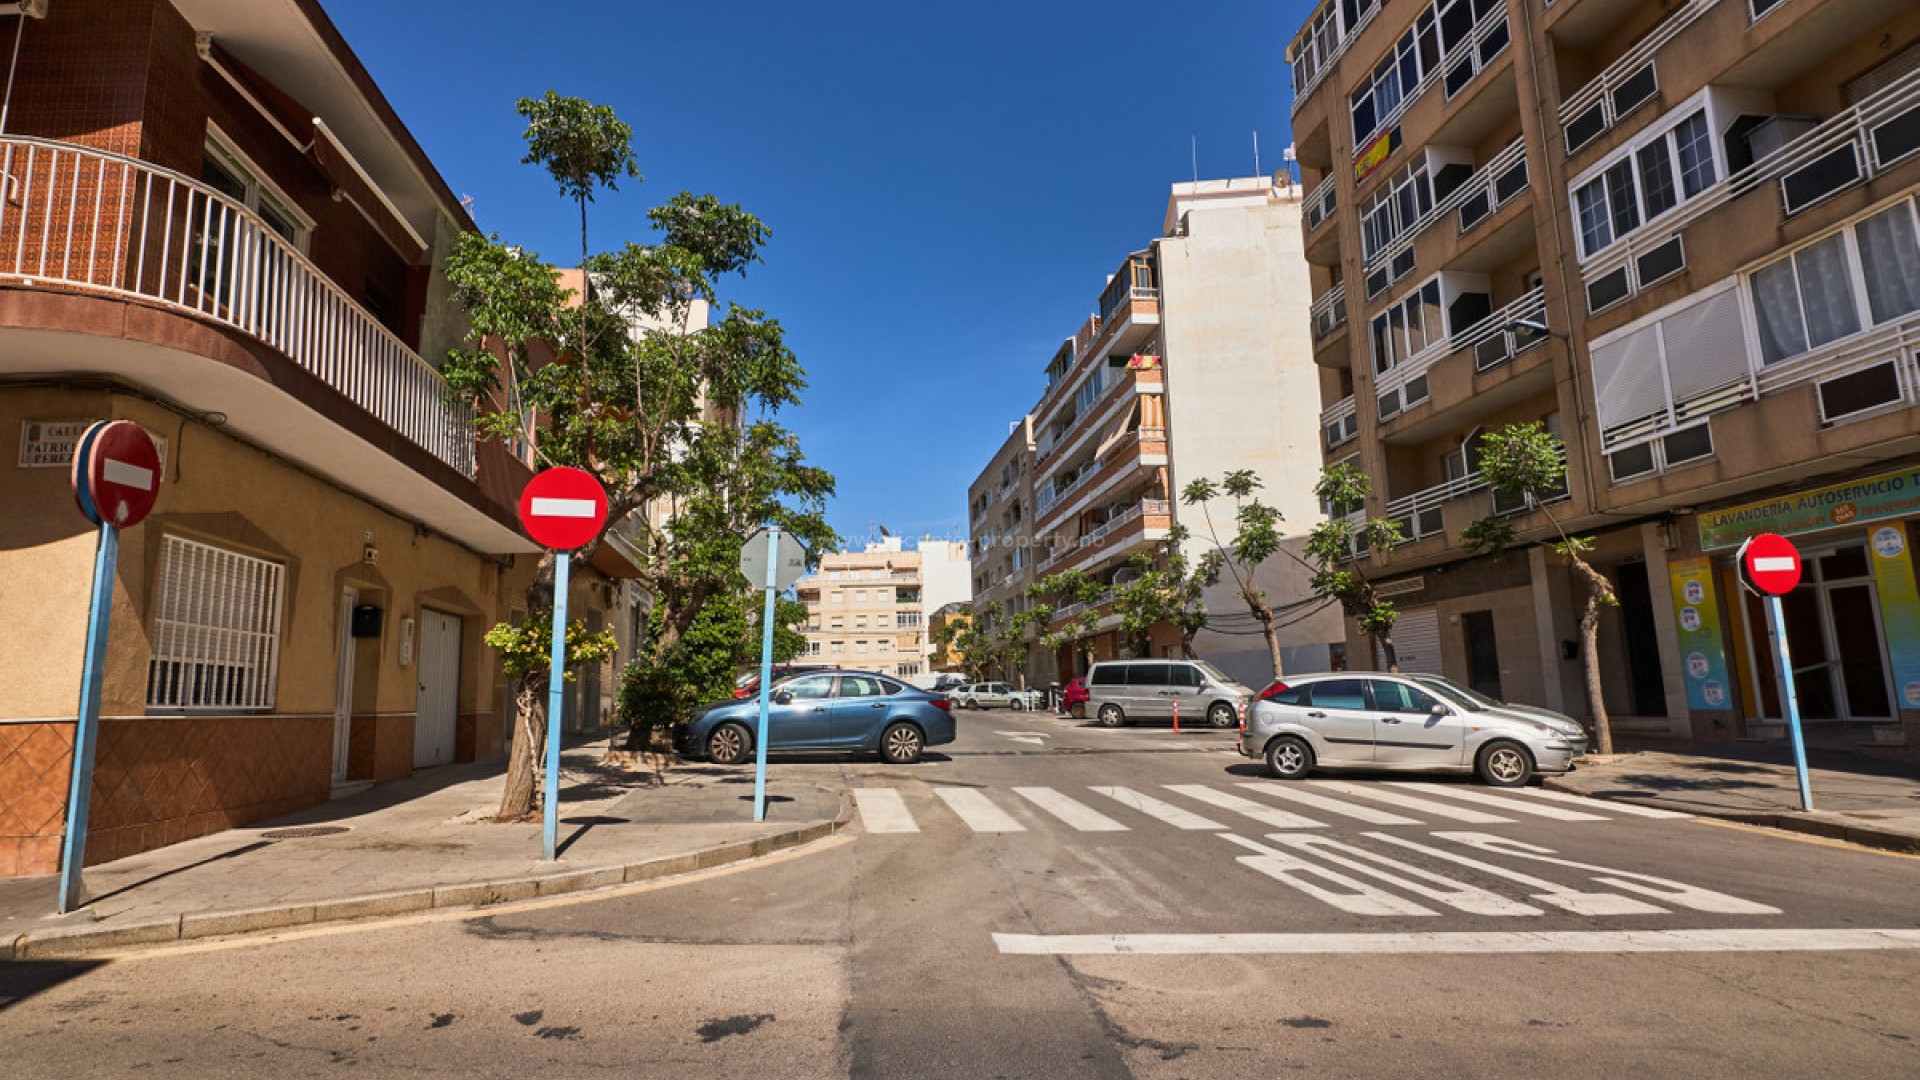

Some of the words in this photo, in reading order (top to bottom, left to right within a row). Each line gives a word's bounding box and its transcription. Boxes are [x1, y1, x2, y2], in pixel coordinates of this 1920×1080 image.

[27, 443, 76, 453] PATRICI
[1797, 476, 1905, 509] AUTOSERVICIO
[1216, 831, 1783, 916] STOP
